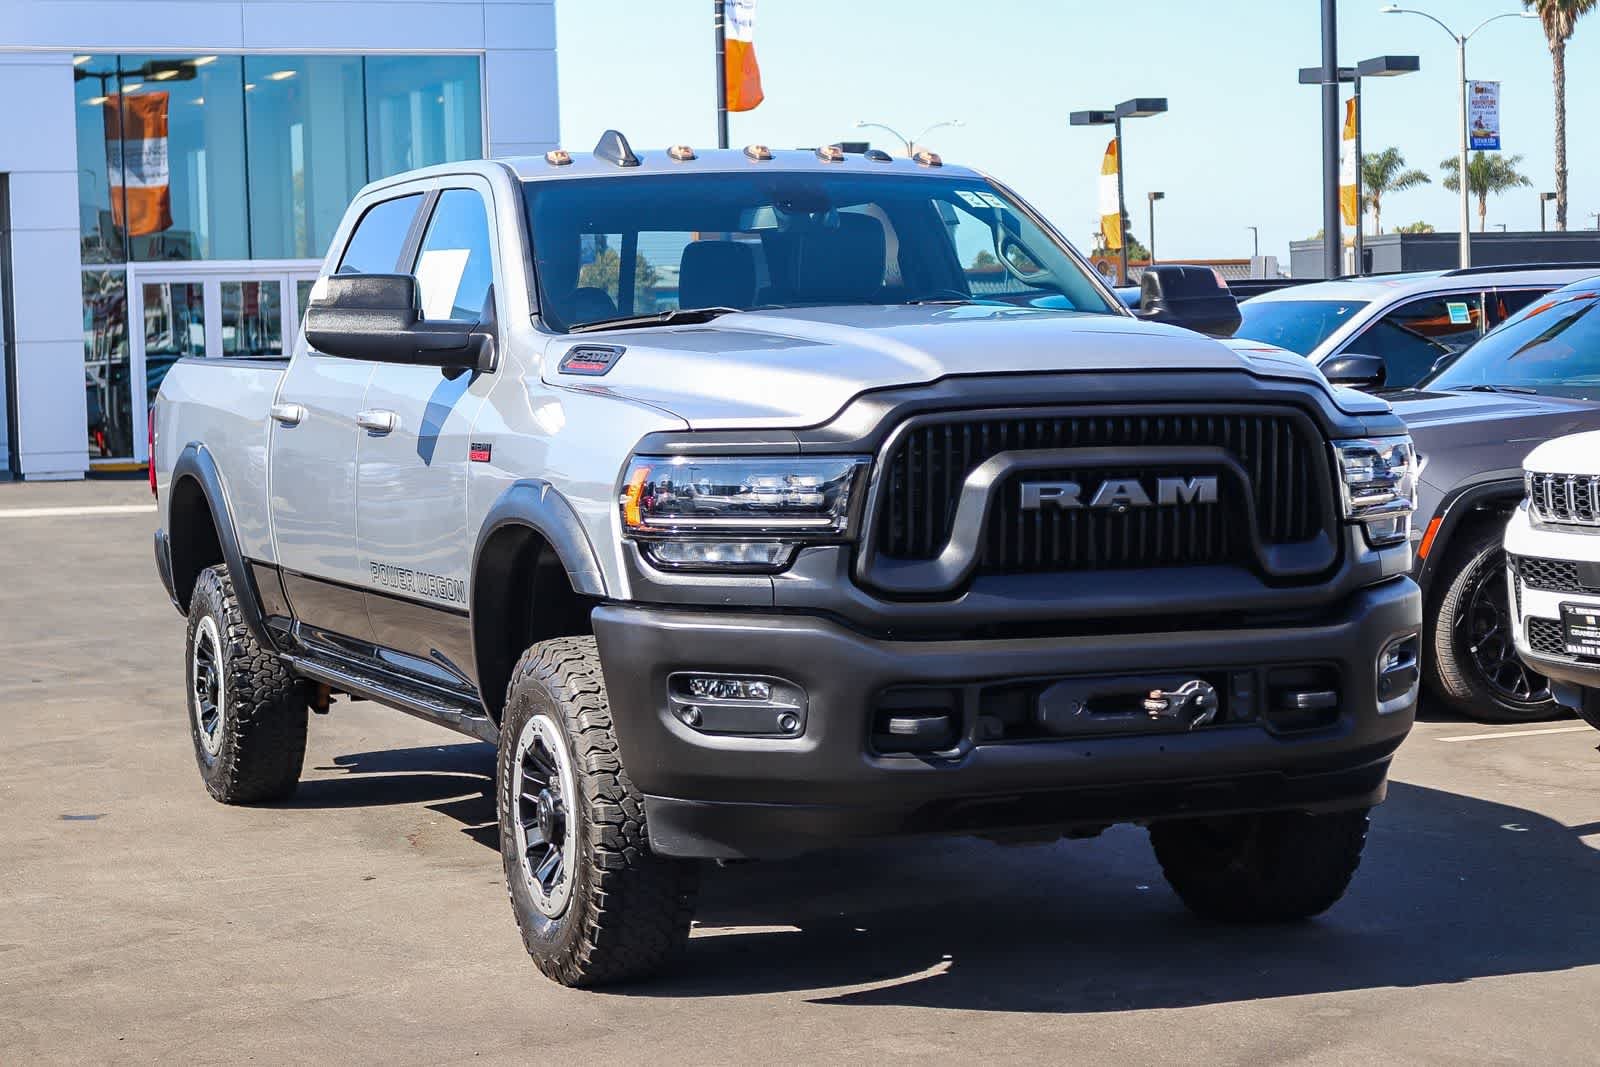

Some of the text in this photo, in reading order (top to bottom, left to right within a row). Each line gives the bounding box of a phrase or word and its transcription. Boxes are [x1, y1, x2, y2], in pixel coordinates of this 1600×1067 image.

[1020, 474, 1218, 509] RAM
[370, 561, 466, 604] POWER WAGON
